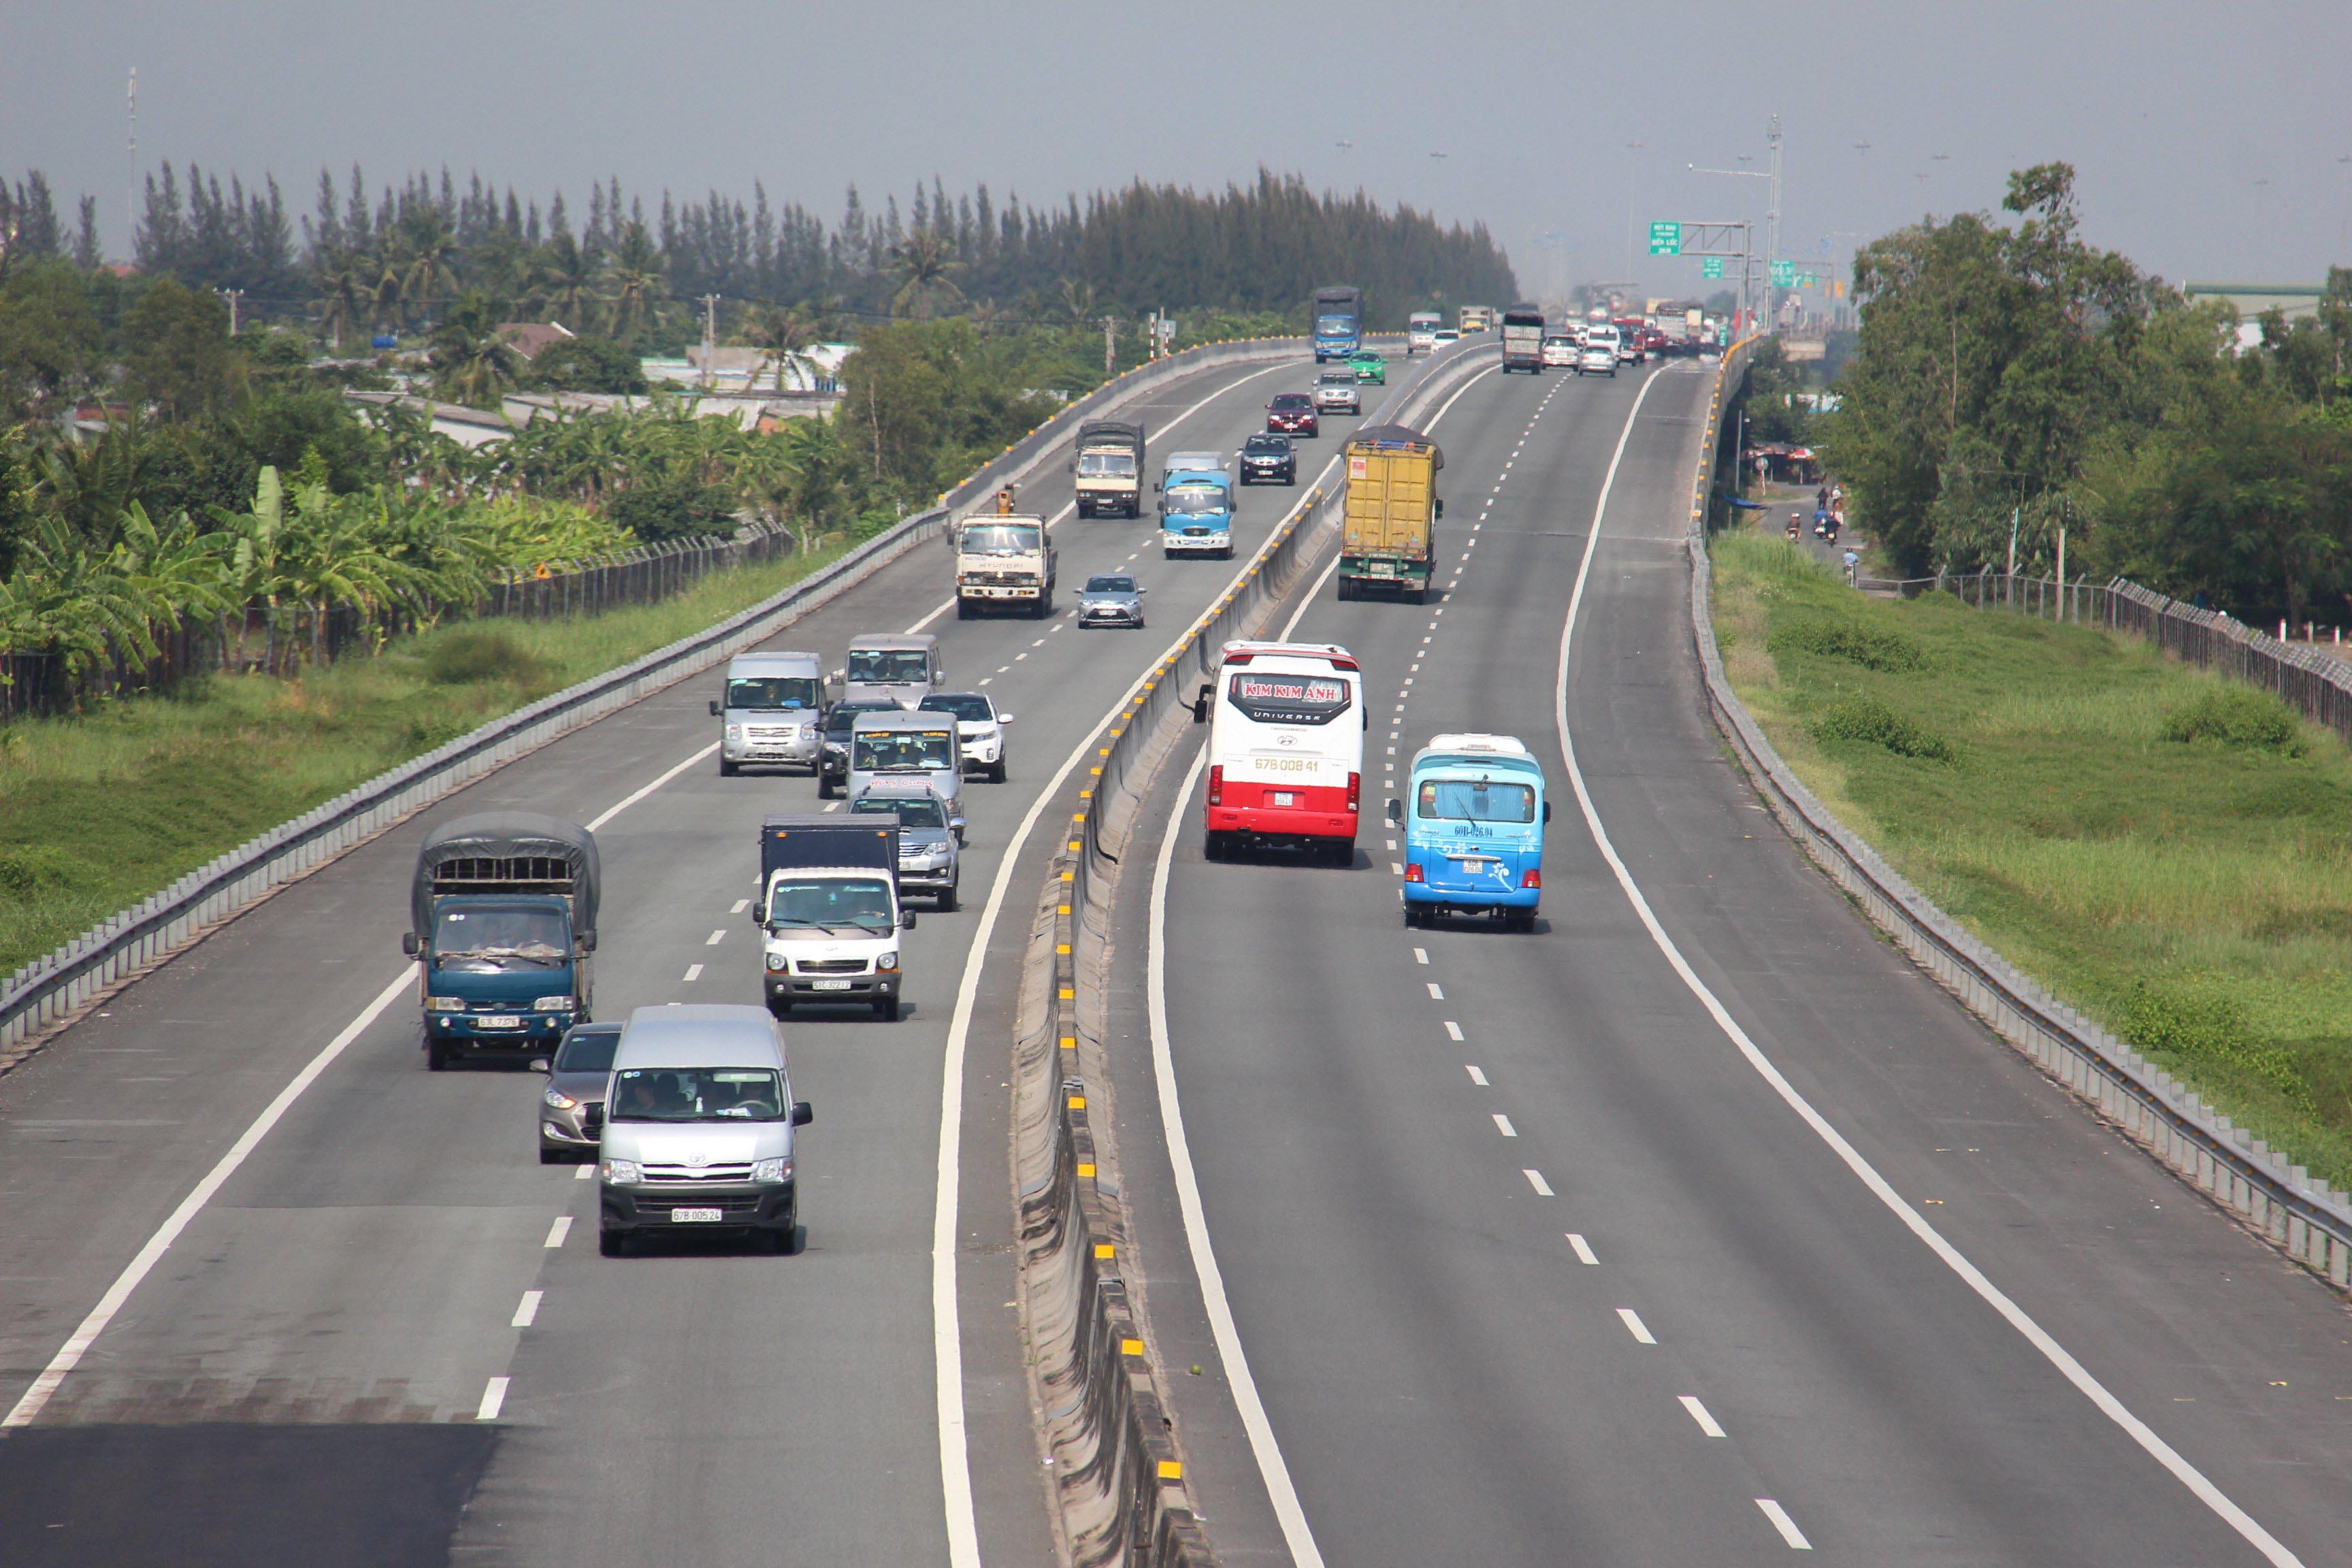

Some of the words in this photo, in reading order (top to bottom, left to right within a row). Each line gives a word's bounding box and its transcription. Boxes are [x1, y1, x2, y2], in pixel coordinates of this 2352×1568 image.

[1245, 683, 1272, 697] KIM
[1273, 685, 1303, 699] KIM
[1303, 687, 1336, 700] ANH
[1254, 711, 1321, 721] UNIVERSE
